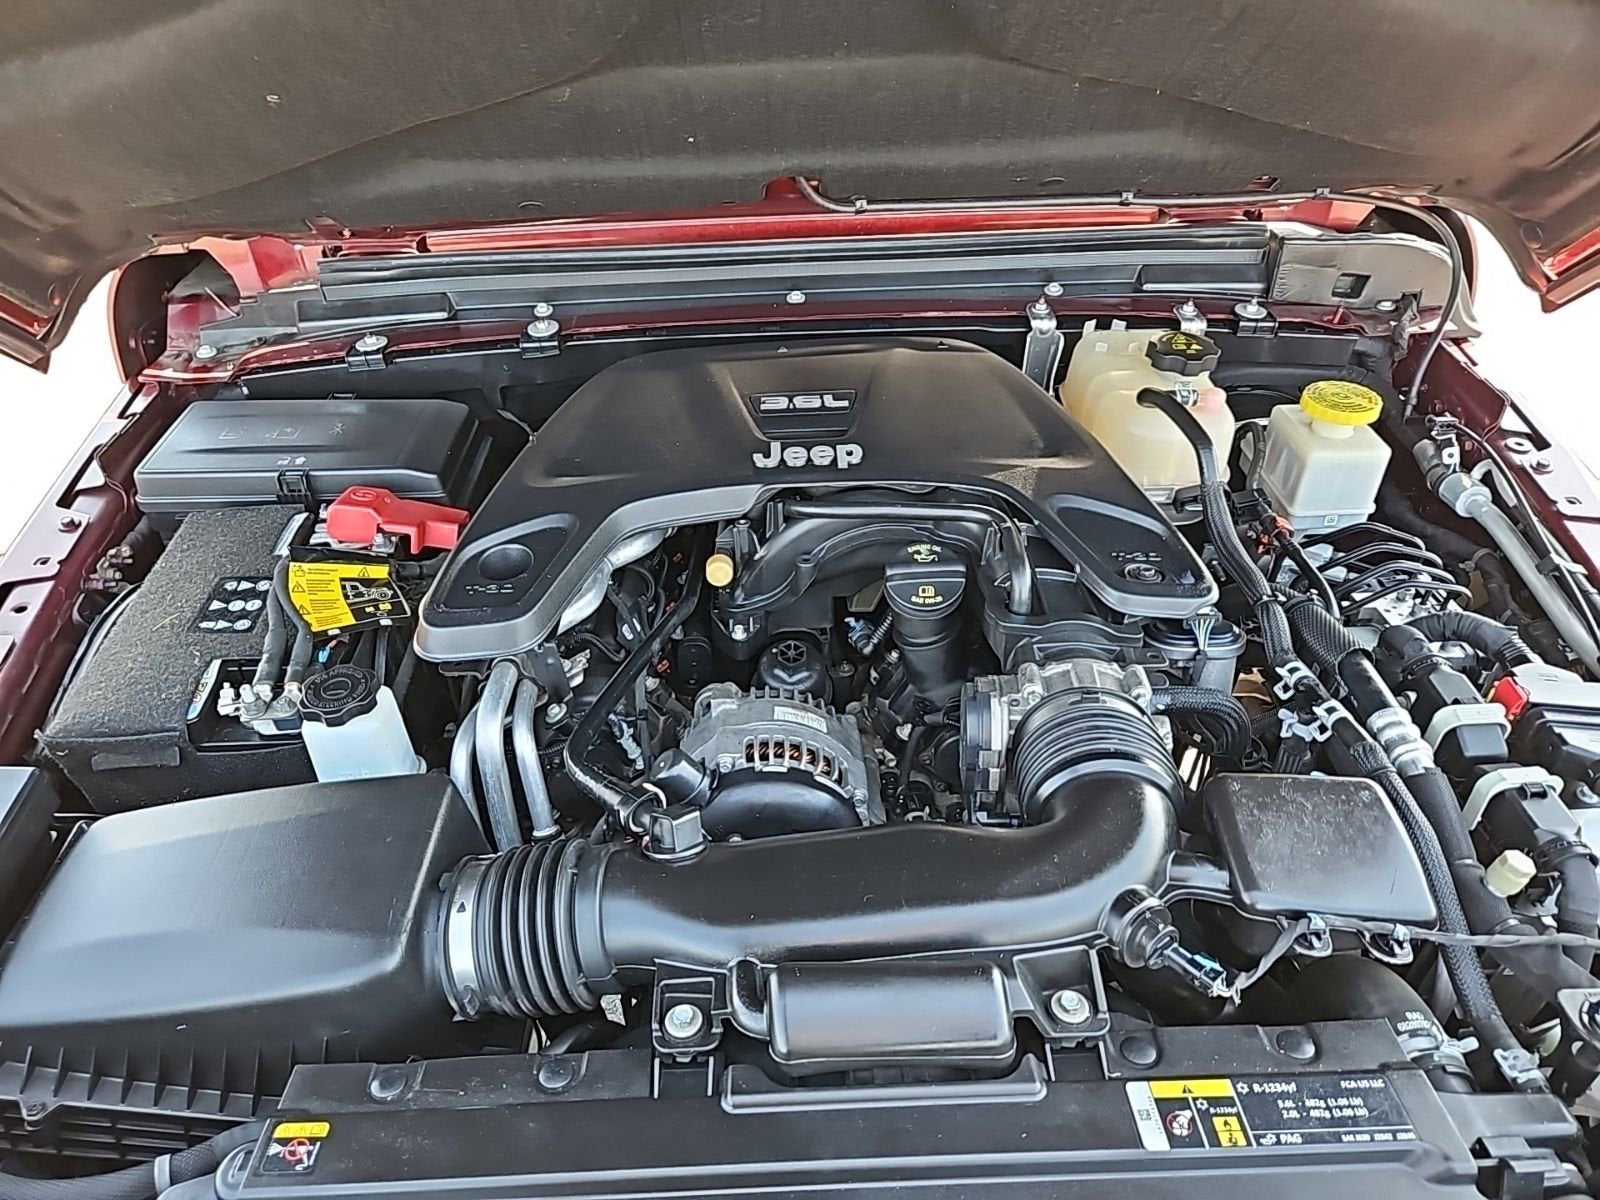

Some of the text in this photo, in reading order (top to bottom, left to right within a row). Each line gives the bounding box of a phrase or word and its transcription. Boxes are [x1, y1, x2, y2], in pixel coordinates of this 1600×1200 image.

[760, 394, 850, 410] 3.6L
[752, 441, 864, 469] Jeep
[932, 545, 943, 553] OIL
[1280, 1133, 1303, 1144] PAG
